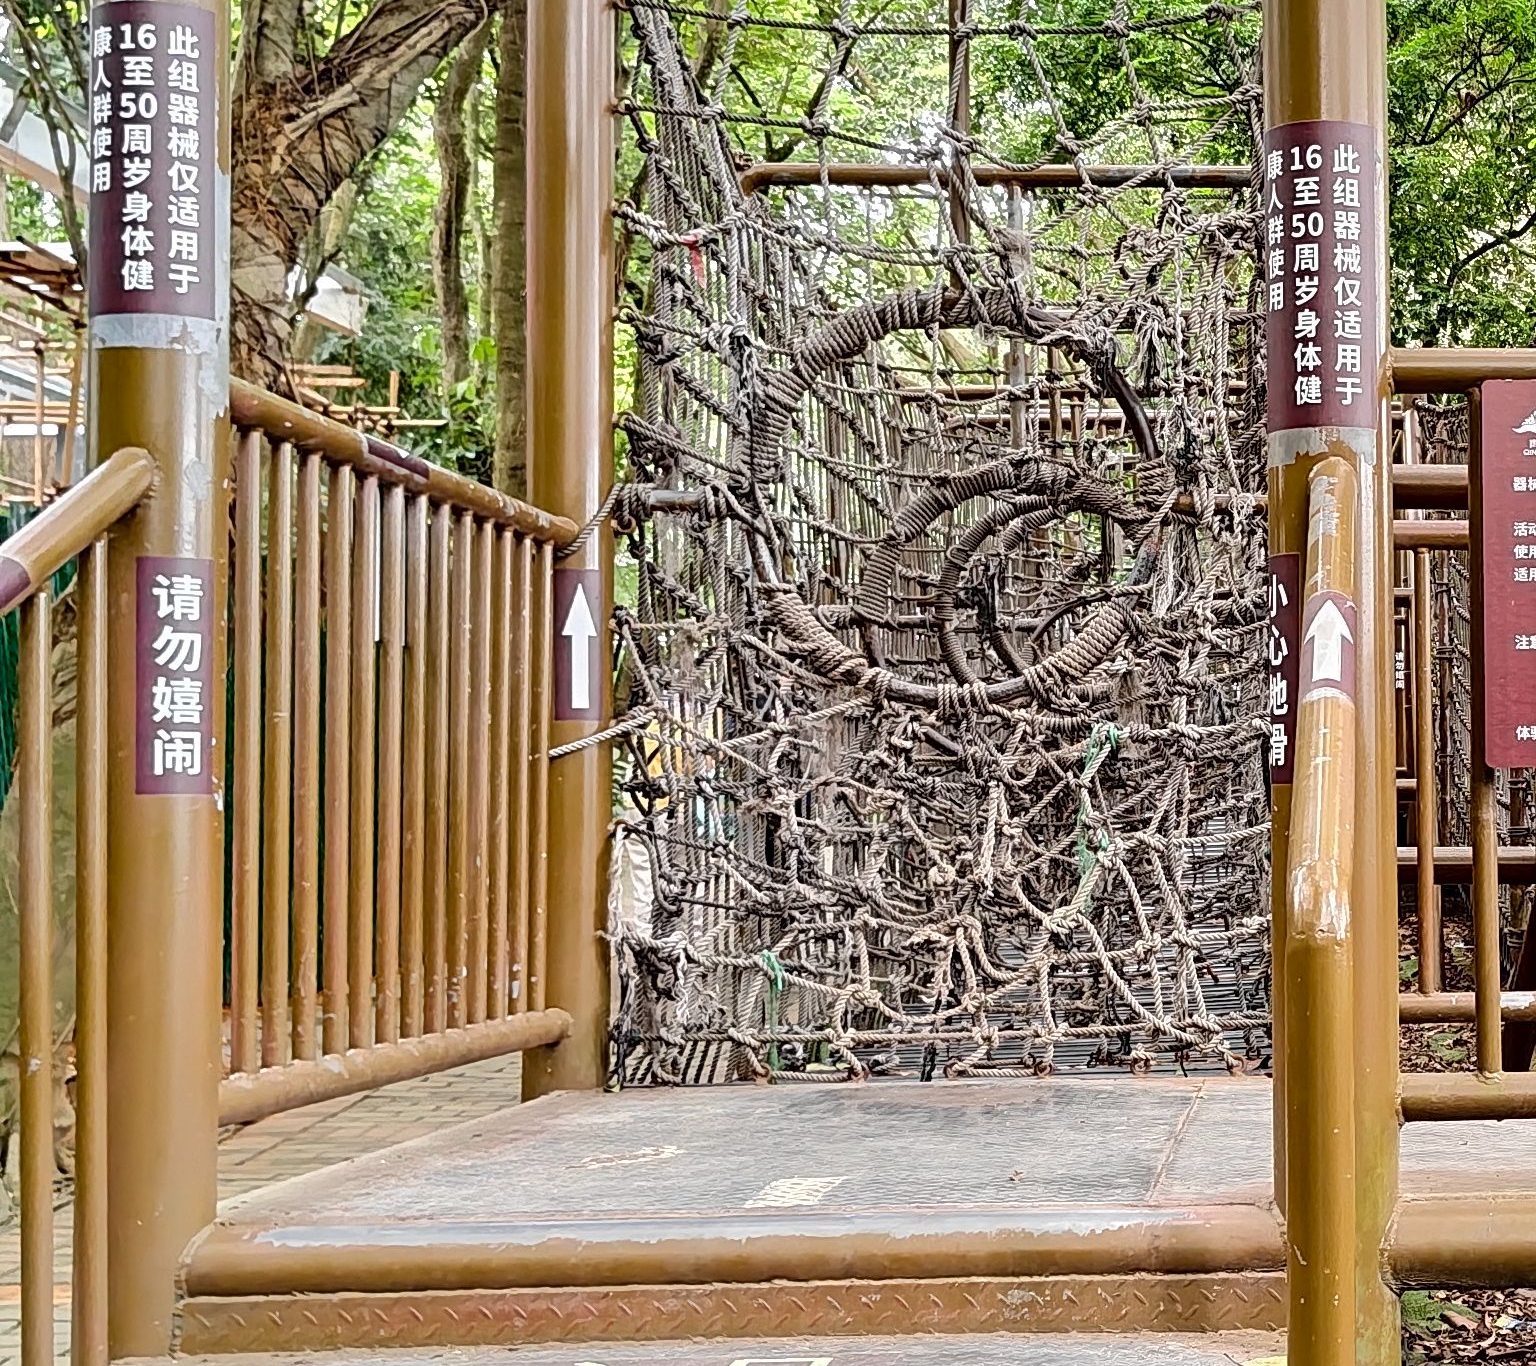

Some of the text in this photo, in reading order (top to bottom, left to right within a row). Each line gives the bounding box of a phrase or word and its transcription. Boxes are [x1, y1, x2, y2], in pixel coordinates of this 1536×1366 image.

[92, 25, 113, 194] 康人群使用
[118, 22, 158, 291] 16至50周岁身体健
[167, 24, 200, 295] 此组器械仅适用于
[1267, 149, 1284, 313] 康人群使用
[1290, 143, 1324, 406] 16至50周岁身体健
[1332, 143, 1363, 406] 此组器械仅适用于
[151, 573, 204, 777] 请勿嬉闹
